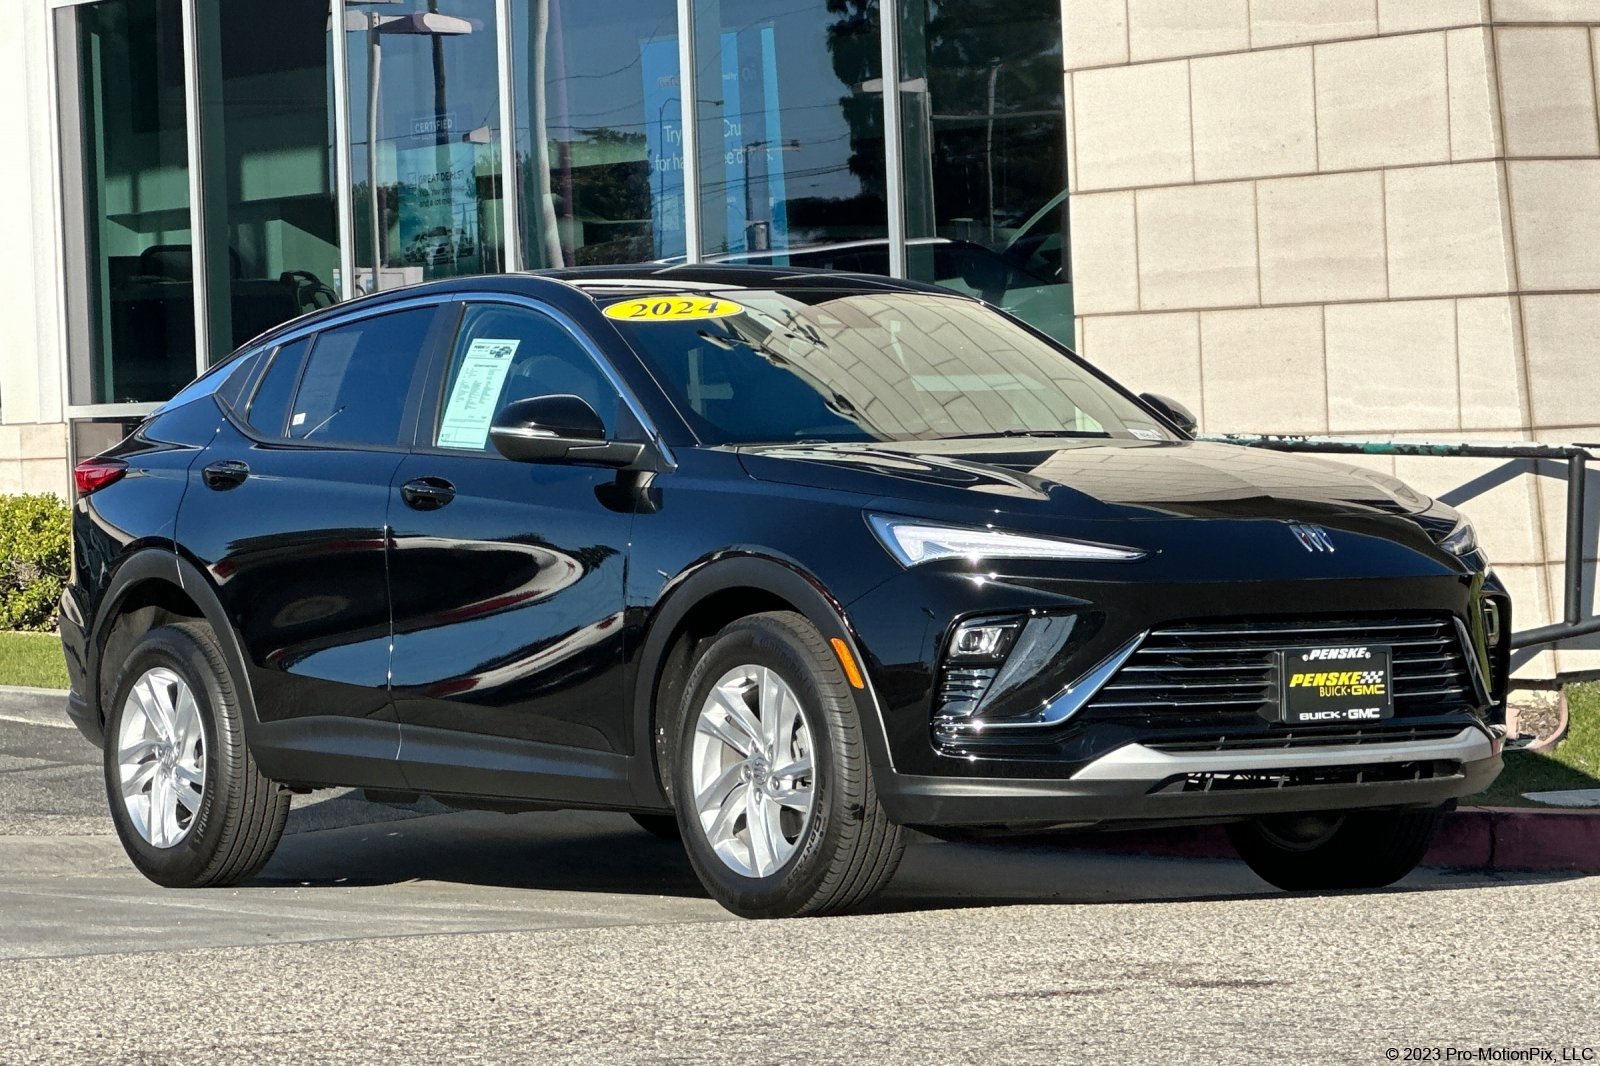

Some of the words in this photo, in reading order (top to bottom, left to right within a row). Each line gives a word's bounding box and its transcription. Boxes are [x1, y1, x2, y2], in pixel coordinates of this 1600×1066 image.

[414, 118, 453, 134] CERTIFIED
[663, 125, 682, 146] Try
[655, 154, 671, 172] for
[629, 301, 719, 318] 2024
[1309, 647, 1367, 660] PENSKE
[1289, 671, 1363, 688] PENSKE
[1320, 685, 1347, 697] BUICK
[1351, 684, 1386, 696] GMC
[1299, 710, 1340, 720] BUICK
[1347, 707, 1380, 719] GMC
